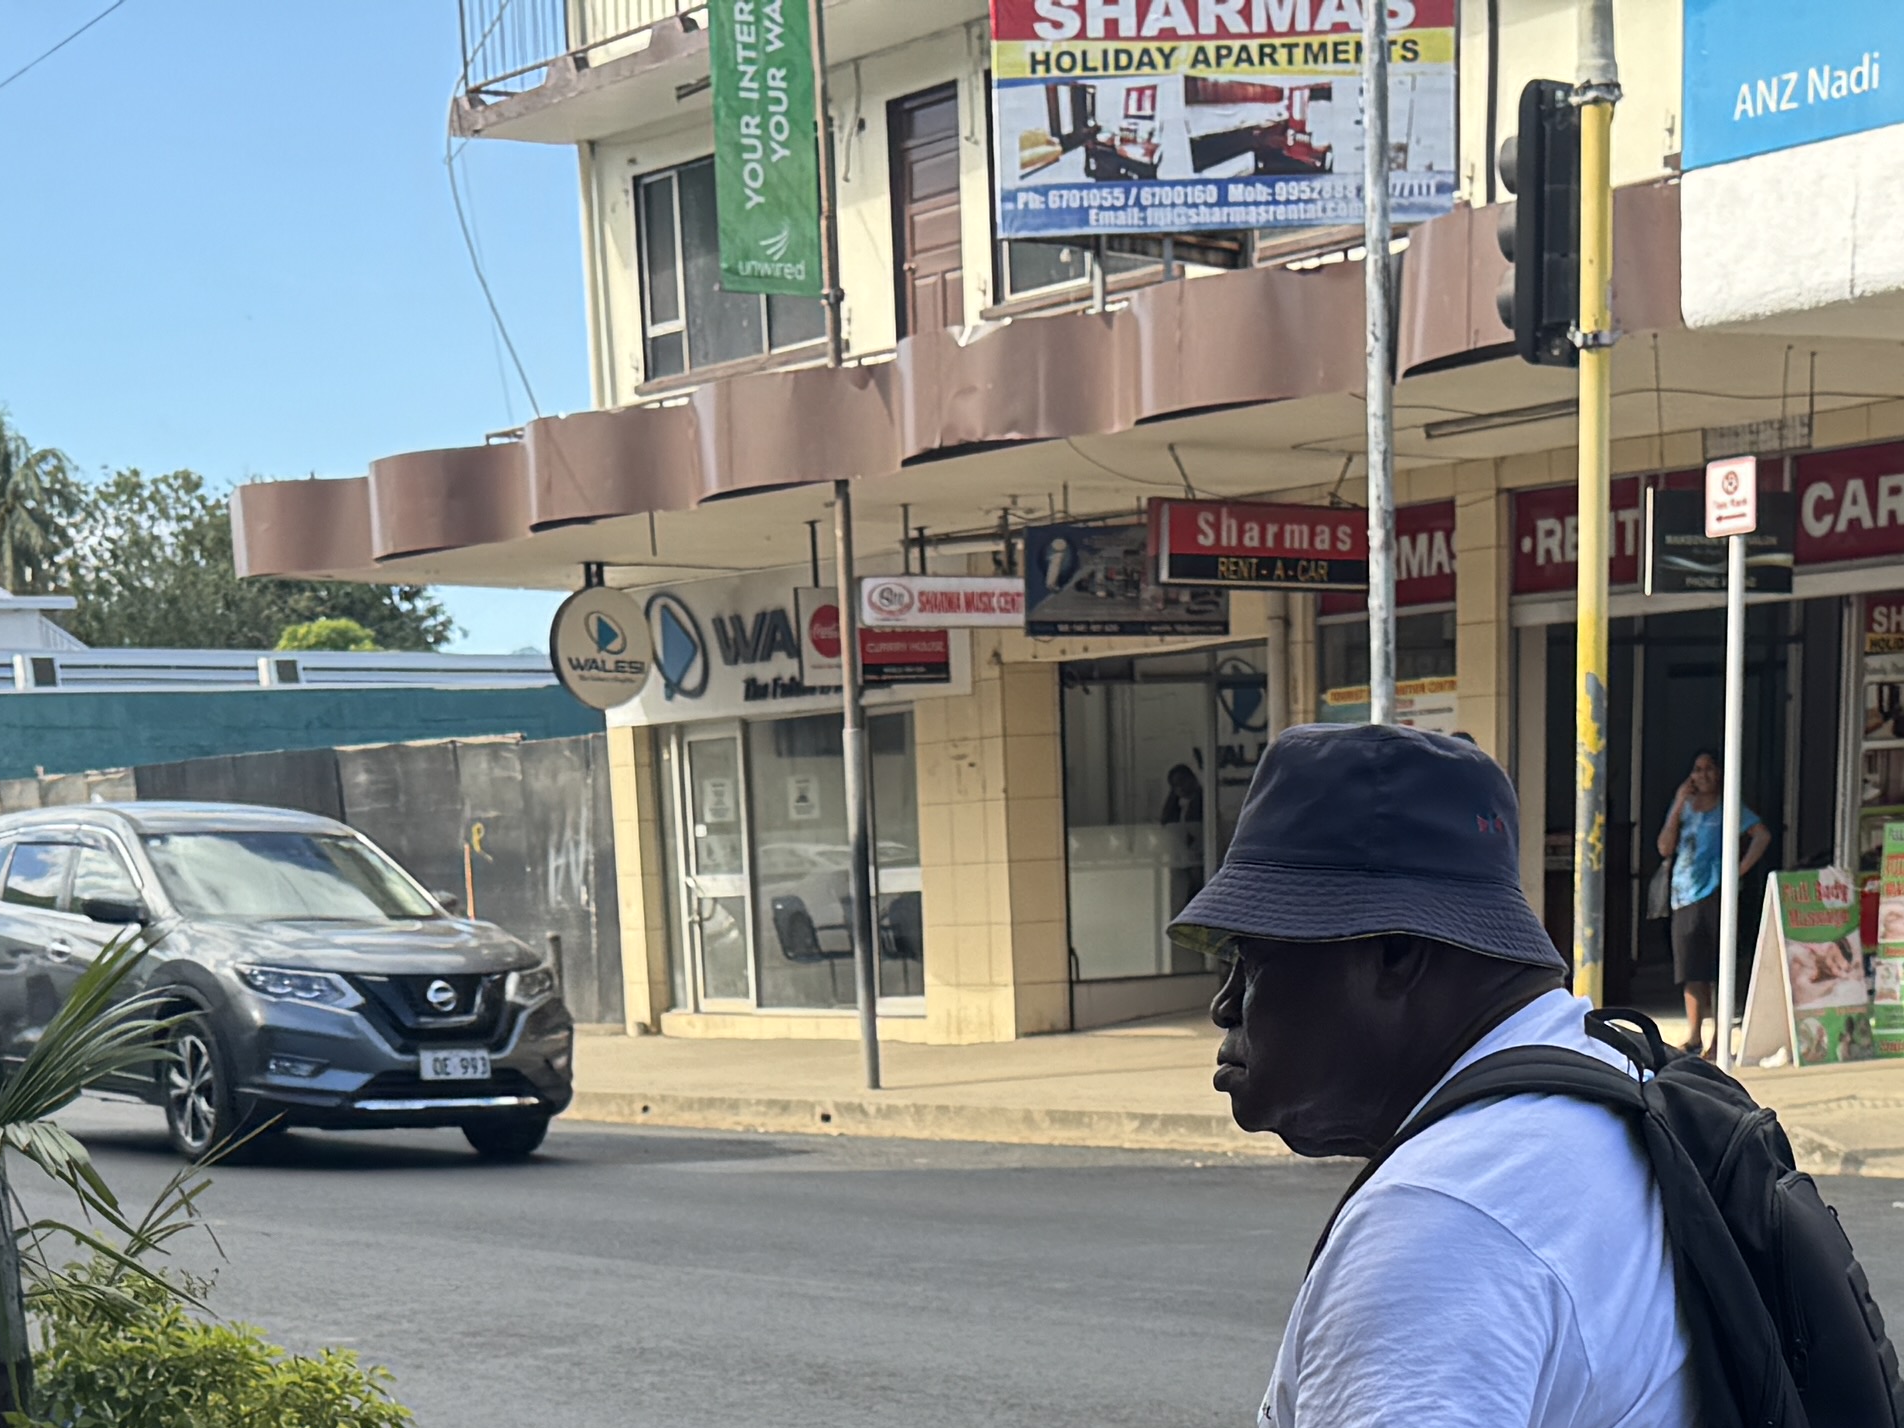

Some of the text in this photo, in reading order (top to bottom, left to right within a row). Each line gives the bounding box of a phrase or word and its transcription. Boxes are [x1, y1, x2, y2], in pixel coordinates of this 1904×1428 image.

[1030, 46, 1178, 76] HOLIDAY
[1733, 51, 1881, 122] ANZ Nadi
[767, 67, 791, 163] YOUR
[740, 114, 766, 210] YOUR
[737, 256, 807, 281] unwired
[1196, 507, 1353, 551] Sharmas
[1217, 557, 1259, 580] RENT
[1273, 563, 1286, 580] A
[1297, 560, 1329, 582] CAR
